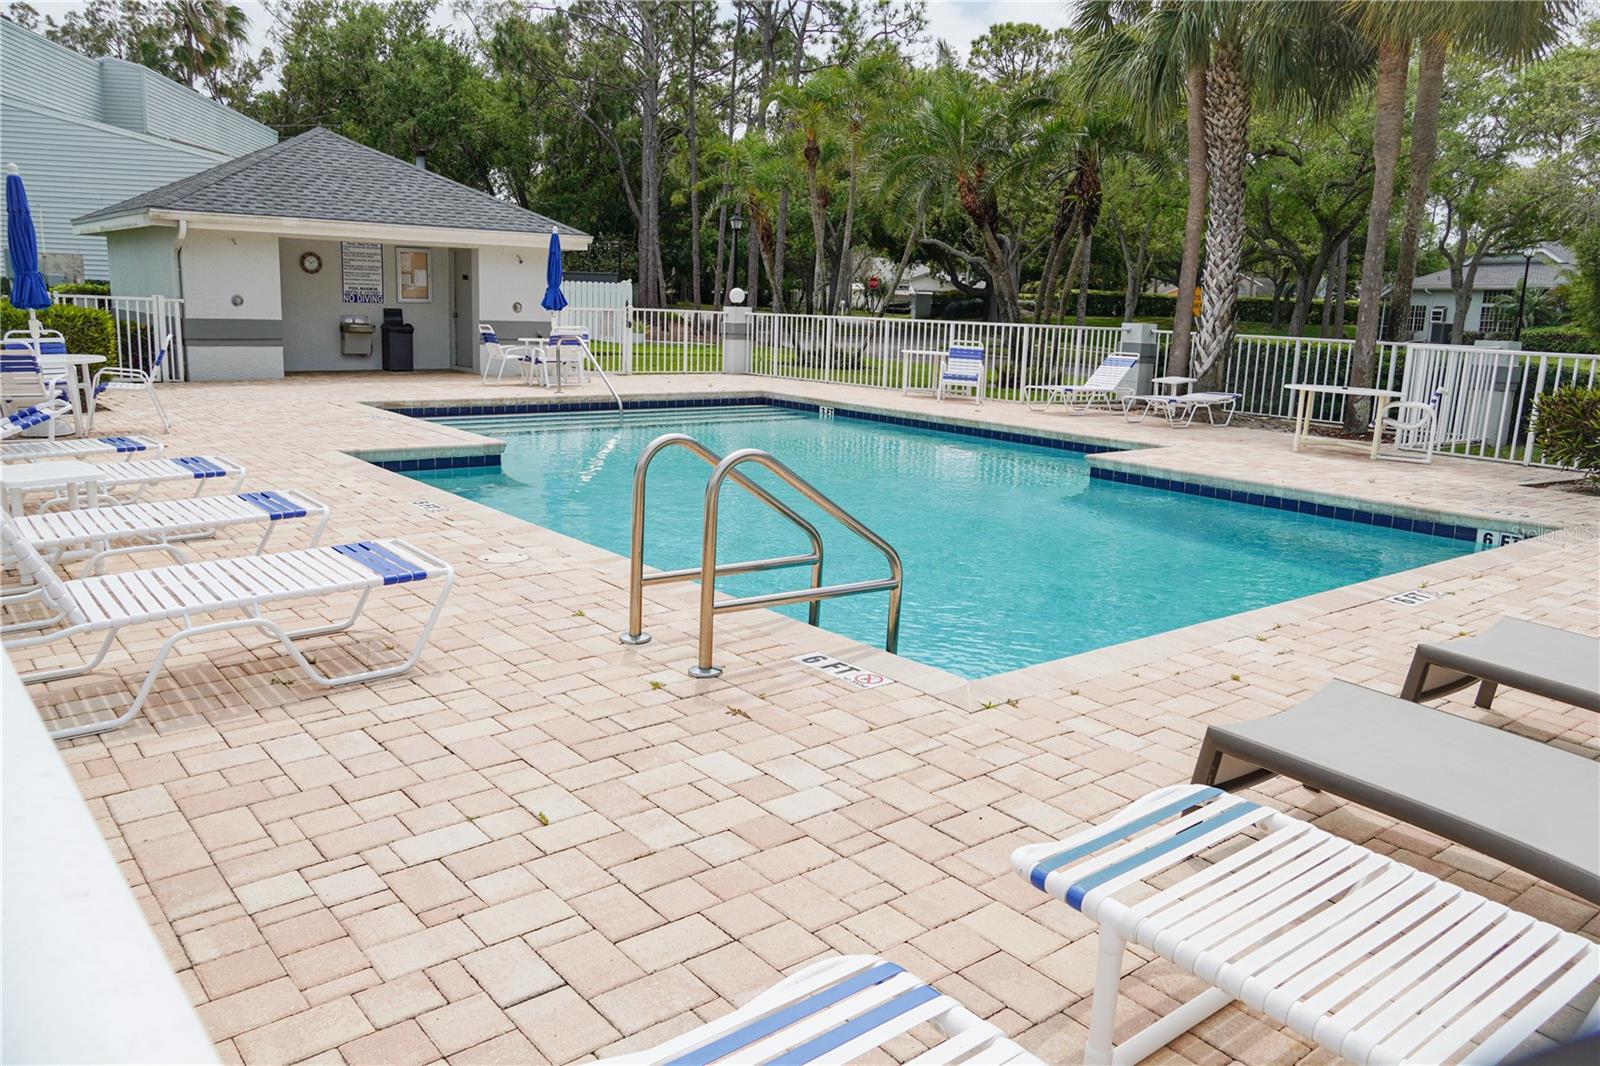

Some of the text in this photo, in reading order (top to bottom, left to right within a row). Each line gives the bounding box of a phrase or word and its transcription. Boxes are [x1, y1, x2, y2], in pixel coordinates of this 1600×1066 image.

[344, 294, 384, 303] NO DIVING
[1482, 532, 1494, 547] 6
[1402, 592, 1431, 601] FT
[801, 655, 861, 675] 6 FT
